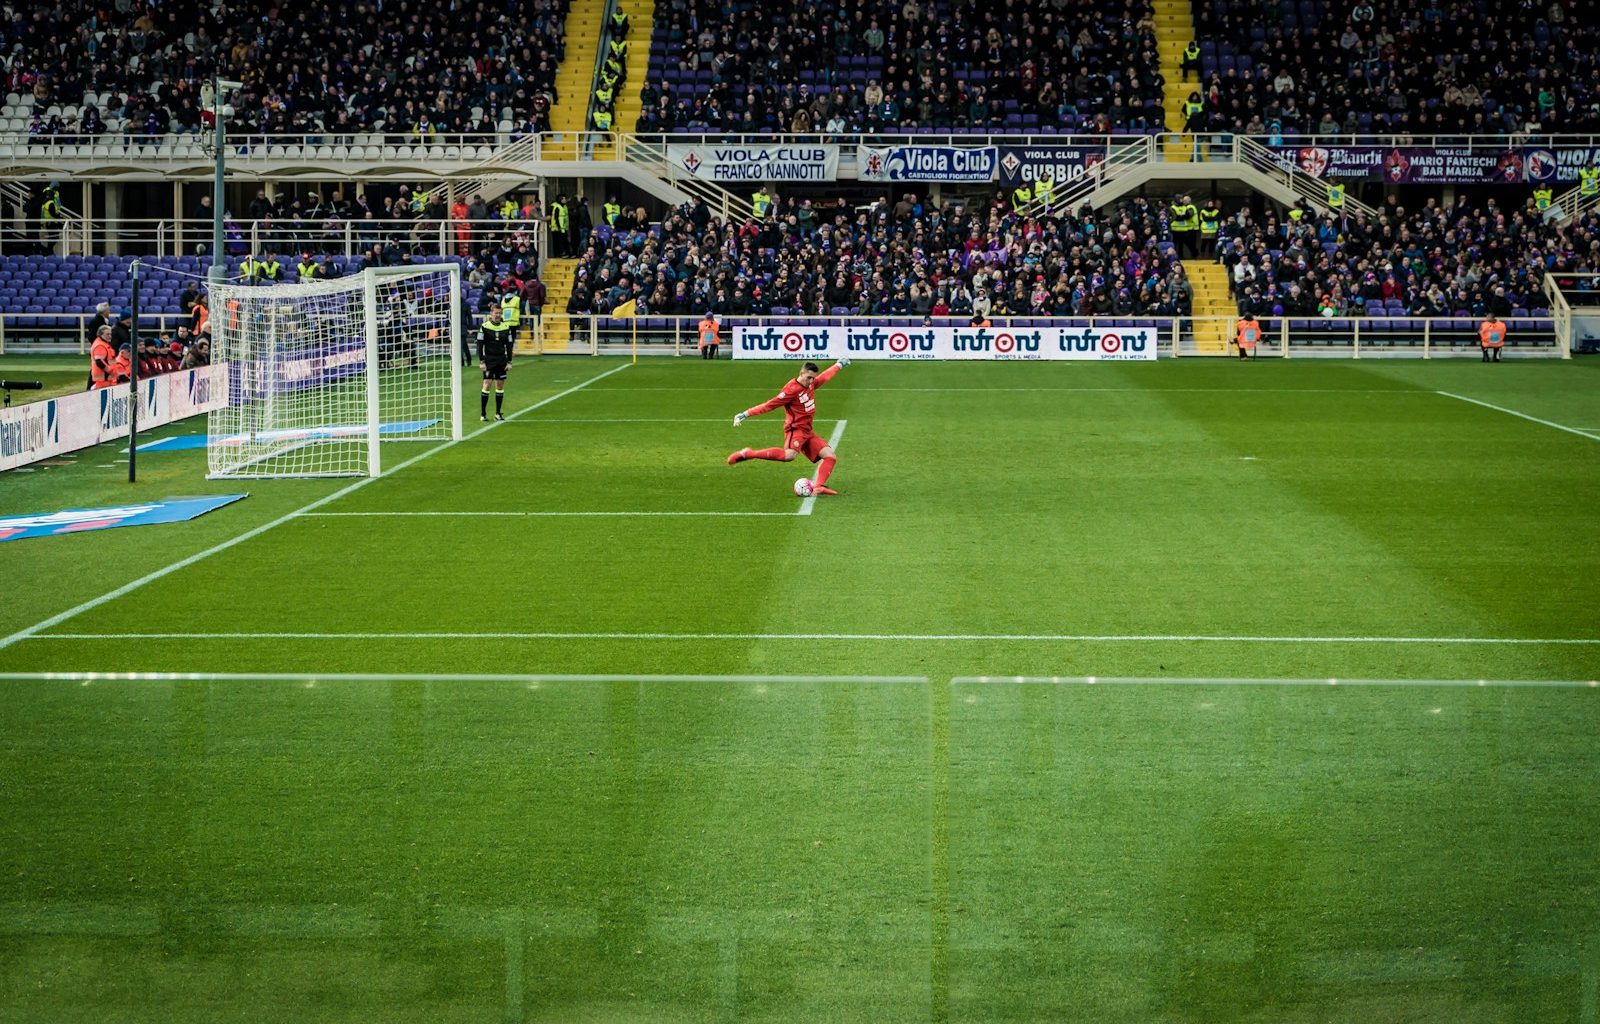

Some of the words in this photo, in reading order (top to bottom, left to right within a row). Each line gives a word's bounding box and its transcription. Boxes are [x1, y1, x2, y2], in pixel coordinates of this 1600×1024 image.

[715, 149, 770, 161] VIOLA
[777, 149, 826, 161] CLUB
[905, 149, 948, 171] Viola
[952, 150, 991, 172] Club
[1024, 151, 1052, 159] VIOLA
[1055, 151, 1080, 159] CLUB
[1330, 149, 1382, 166] Bianchi
[1410, 156, 1444, 166] MARIO
[1446, 157, 1497, 167] FANTECHI
[1557, 149, 1600, 165] VIOLA
[714, 164, 762, 179] FRANCO
[766, 164, 825, 179] NANNOTTI
[948, 172, 989, 180] FIORENTINO
[1021, 164, 1084, 182] GUBBIO
[1422, 167, 1444, 176] BAR
[1446, 167, 1484, 176] MARISA
[1557, 166, 1579, 180] CASA
[741, 328, 829, 351] infront
[848, 328, 935, 351] infront
[953, 328, 1041, 352] infront
[1059, 329, 1147, 352] infront
